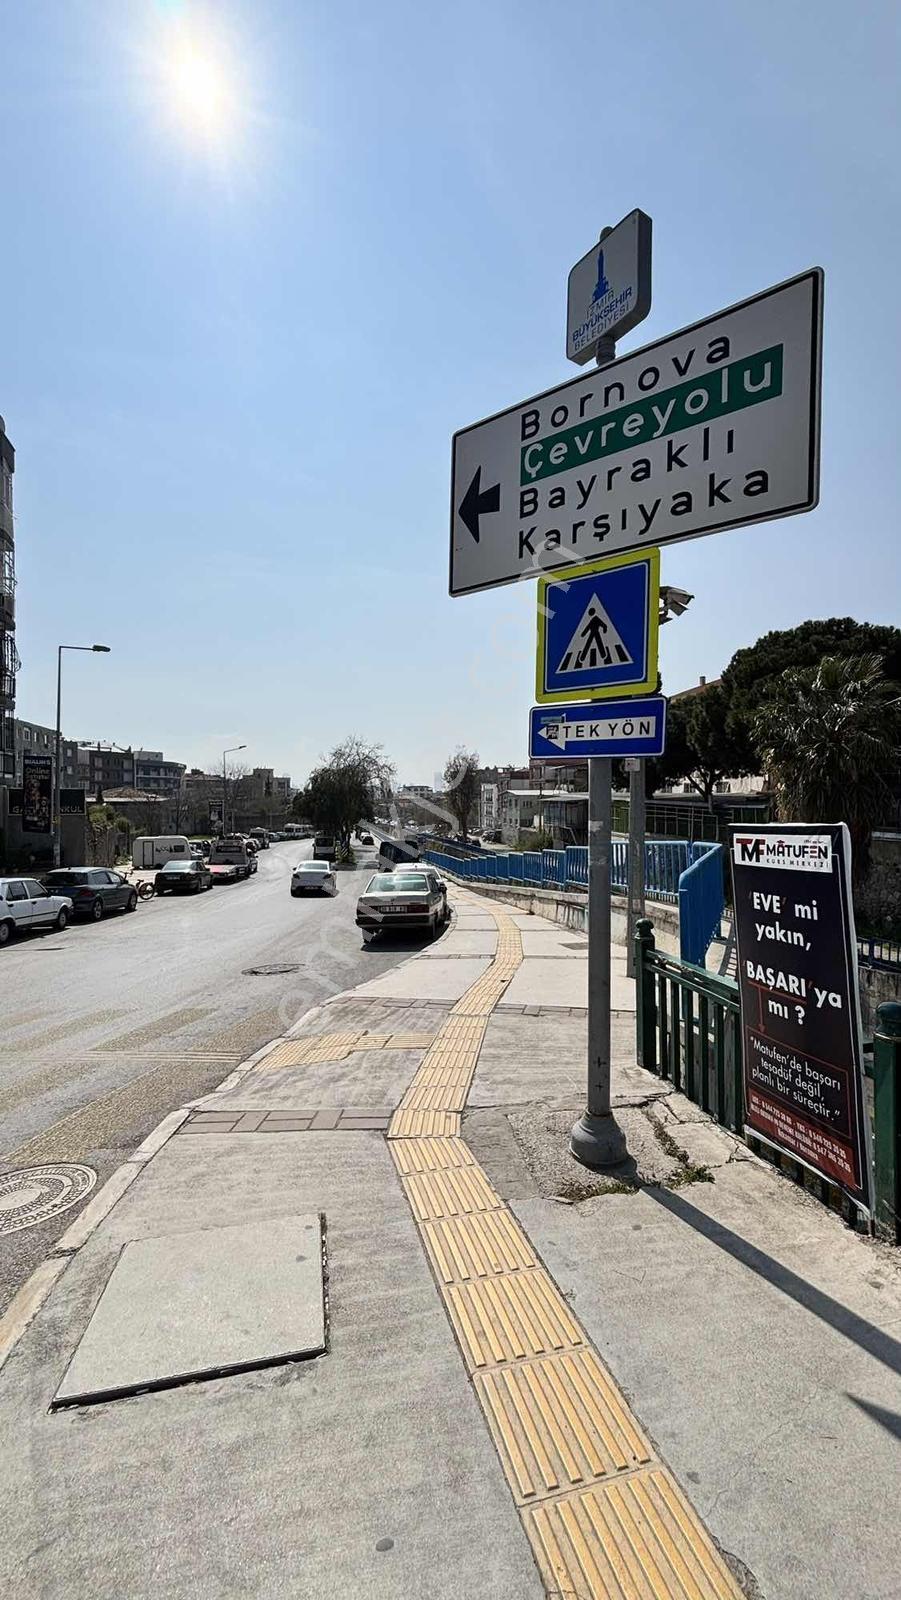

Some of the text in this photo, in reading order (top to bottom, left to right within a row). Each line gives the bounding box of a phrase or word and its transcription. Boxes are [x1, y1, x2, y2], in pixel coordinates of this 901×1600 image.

[520, 335, 731, 442] Bornova
[523, 361, 772, 478] Çevreyolu
[519, 427, 735, 519] Bayraklı
[518, 469, 769, 559] Karşıyaka
[562, 719, 651, 739] TEK YÖN
[794, 899, 818, 920] mi
[755, 921, 812, 951] yakın,
[752, 1065, 775, 1088] planlı
[776, 1076, 791, 1095] bir
[760, 1057, 793, 1082] tesadüf
[804, 1061, 841, 1091] başarı
